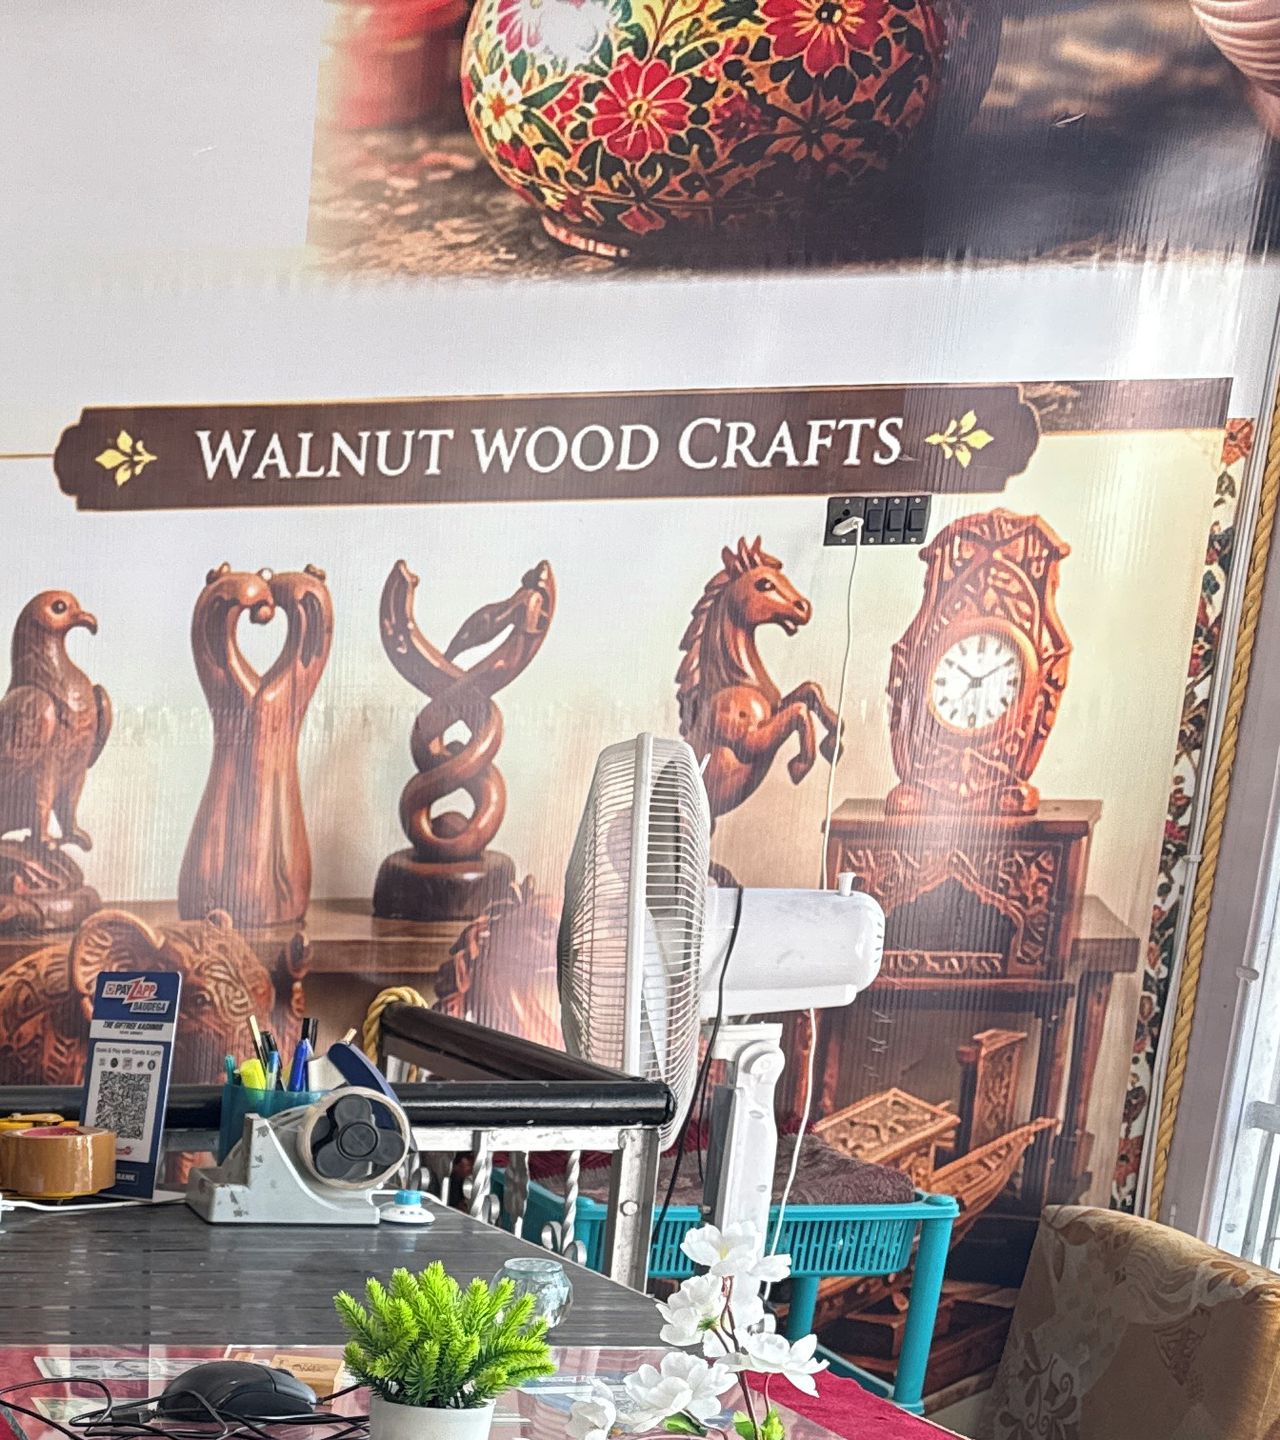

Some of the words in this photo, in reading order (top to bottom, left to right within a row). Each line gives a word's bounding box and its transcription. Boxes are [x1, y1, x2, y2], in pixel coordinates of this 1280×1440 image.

[195, 428, 454, 481] WALNUT
[471, 424, 659, 474] WOOD
[678, 416, 903, 470] CRAFTS
